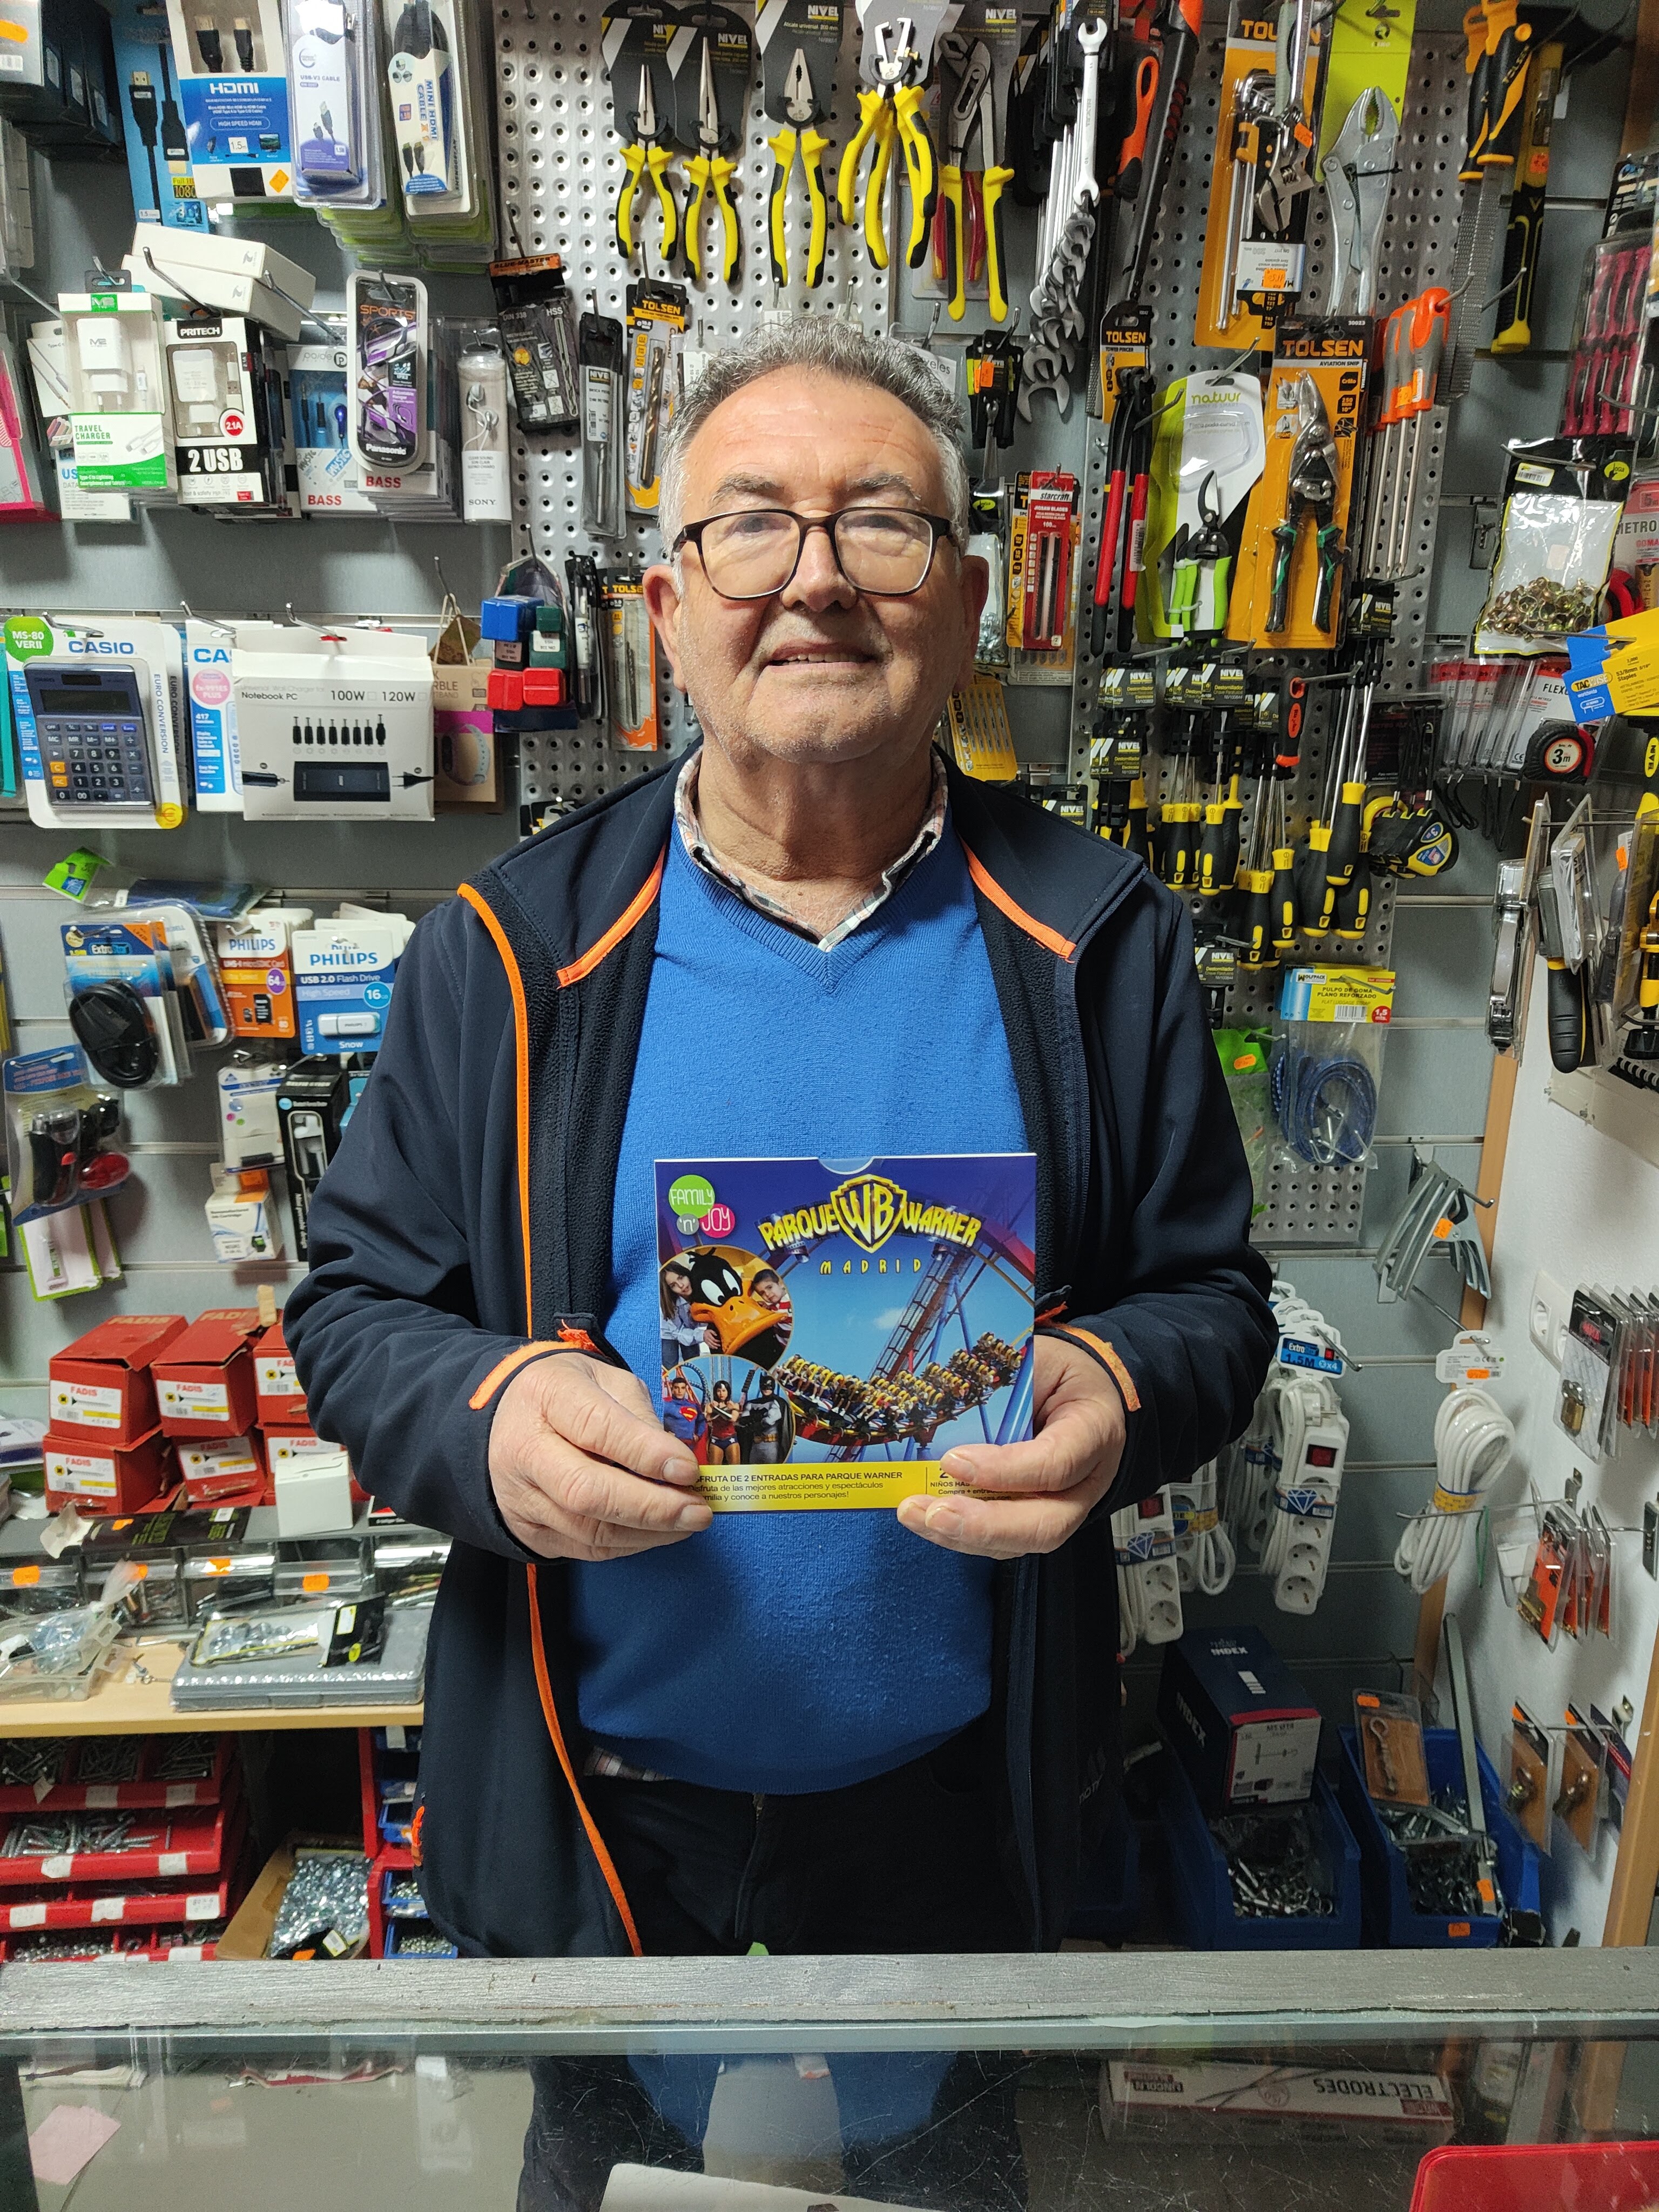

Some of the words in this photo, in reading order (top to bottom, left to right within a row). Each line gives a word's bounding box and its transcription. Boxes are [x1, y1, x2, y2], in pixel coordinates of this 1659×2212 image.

[808, 5, 839, 16] NIVEL
[985, 9, 1017, 19] NIVEL
[718, 33, 748, 45] NIVEL
[210, 83, 259, 94] HDMI
[426, 80, 434, 106] MINI
[417, 84, 427, 120] CABLE
[429, 110, 438, 140] HDMI
[360, 305, 416, 320] SPORTS
[547, 307, 563, 316] HSS
[643, 300, 680, 315] TOLSEN
[180, 327, 220, 336] PRITECH
[1106, 331, 1146, 343] TOLSEN
[1283, 340, 1364, 357] TOLSEN
[1191, 392, 1240, 404] natuur
[366, 443, 407, 455] Panasonic
[188, 449, 201, 473] 2
[203, 448, 243, 472] USB
[366, 476, 401, 488] BASS
[308, 495, 342, 505] BASS
[1041, 493, 1070, 501] starcraft
[12, 631, 44, 640] MS-80
[69, 641, 134, 654] CASIO
[194, 649, 232, 663] CA
[1616, 667, 1638, 676] 53/8mm
[1617, 673, 1637, 682] Staples
[154, 674, 162, 696] EURO
[1575, 675, 1609, 691] TACWISE
[241, 692, 284, 700] Notebook
[331, 691, 365, 700] 100W
[382, 692, 415, 702] 120W
[156, 697, 168, 754] CONVERSION
[229, 939, 276, 950] PHILIPS
[309, 952, 378, 966] PHILIPS
[337, 974, 358, 982] Flash
[302, 990, 319, 998] High
[323, 988, 350, 997] Speed
[669, 1188, 714, 1207] FAMILY
[702, 1208, 732, 1232] JOY
[758, 1204, 841, 1252] PARQUE
[844, 1184, 894, 1245] WB
[903, 1198, 982, 1249] WARNER
[820, 1258, 922, 1274] MADRID
[1286, 1353, 1315, 1367] 1.5M
[71, 1386, 97, 1397] FADIS
[176, 1384, 203, 1392] FADIS
[200, 1441, 228, 1450] FADIS
[66, 1458, 91, 1467] FADIS
[804, 1491, 849, 1500] personajes!
[1210, 1647, 1248, 1655] INDEX
[1312, 2078, 1433, 2101] ELECTRODES
